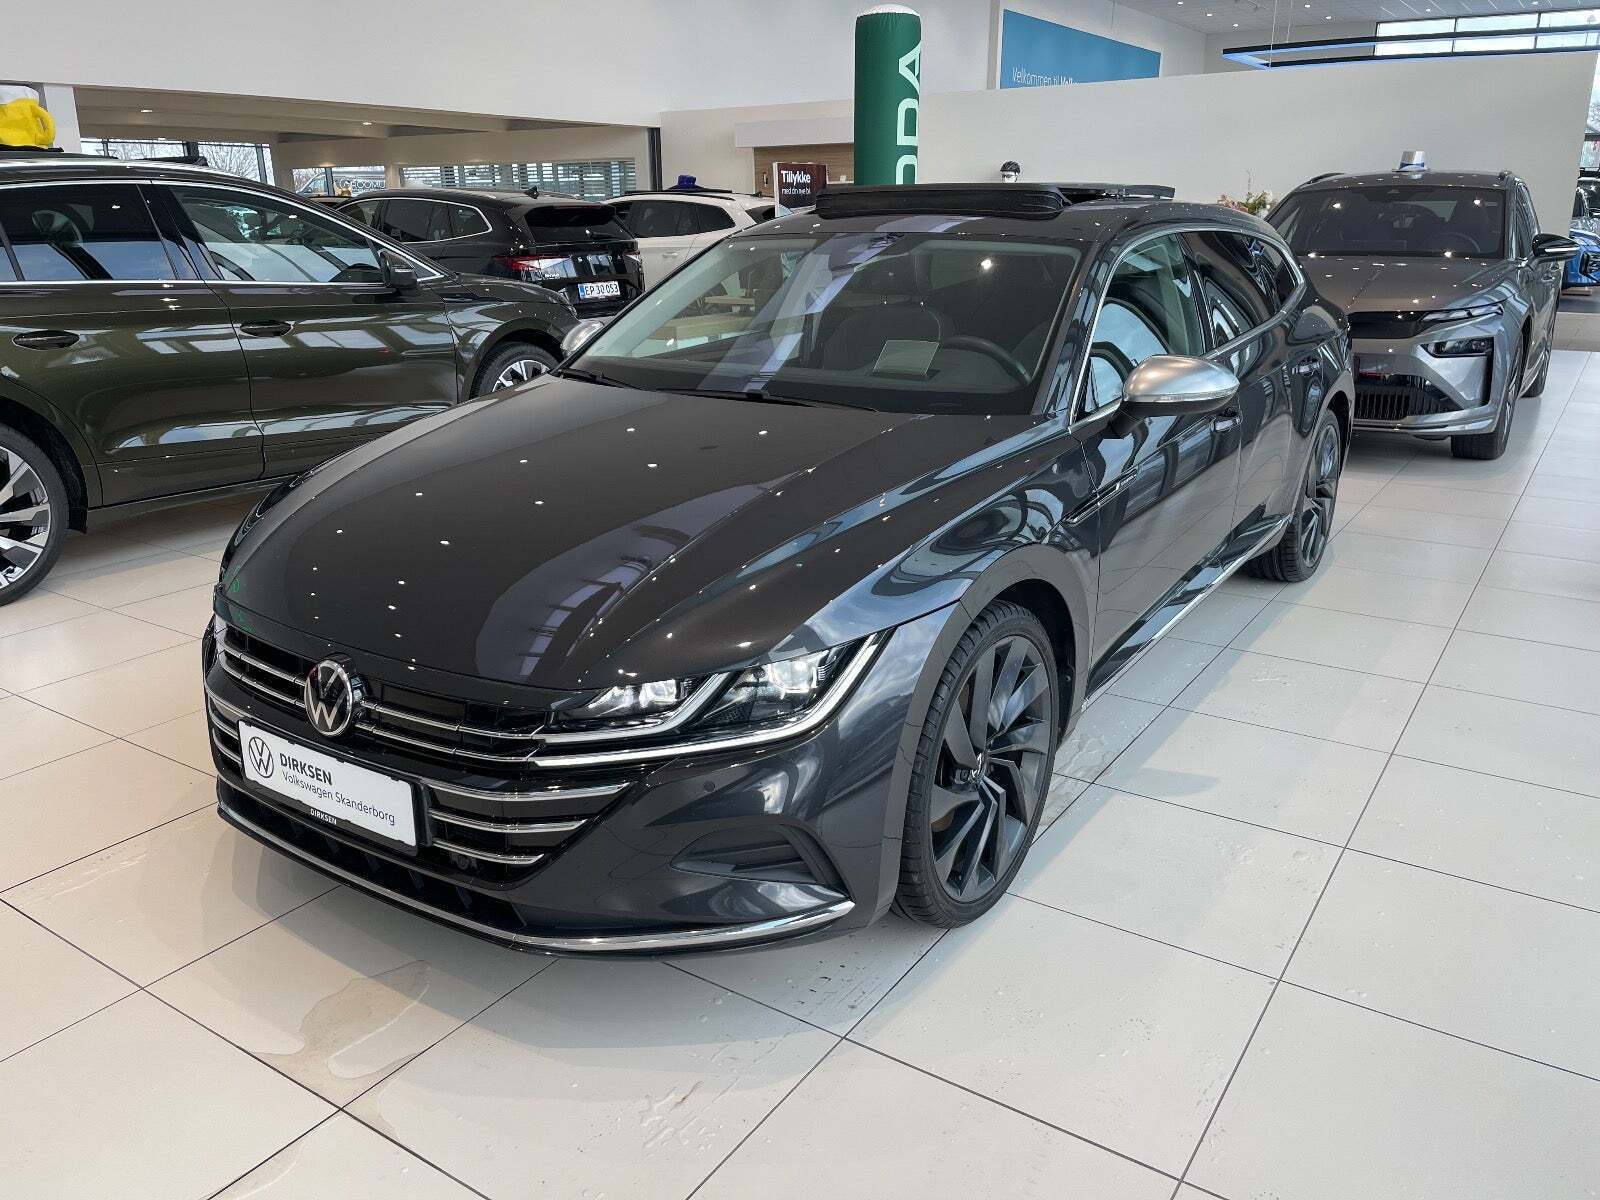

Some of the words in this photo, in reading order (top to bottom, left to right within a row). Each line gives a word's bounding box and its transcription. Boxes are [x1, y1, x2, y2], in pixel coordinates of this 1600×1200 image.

[1012, 66, 1052, 87] Velkommen
[781, 170, 811, 186] Tillykke
[585, 286, 595, 295] EP
[596, 285, 605, 294] 30
[605, 283, 619, 294] 053
[280, 752, 333, 786] DIRKSEN
[282, 770, 334, 801] Volkswagen
[335, 791, 396, 826] Skanderborg
[310, 808, 337, 825] DIRKSEN
